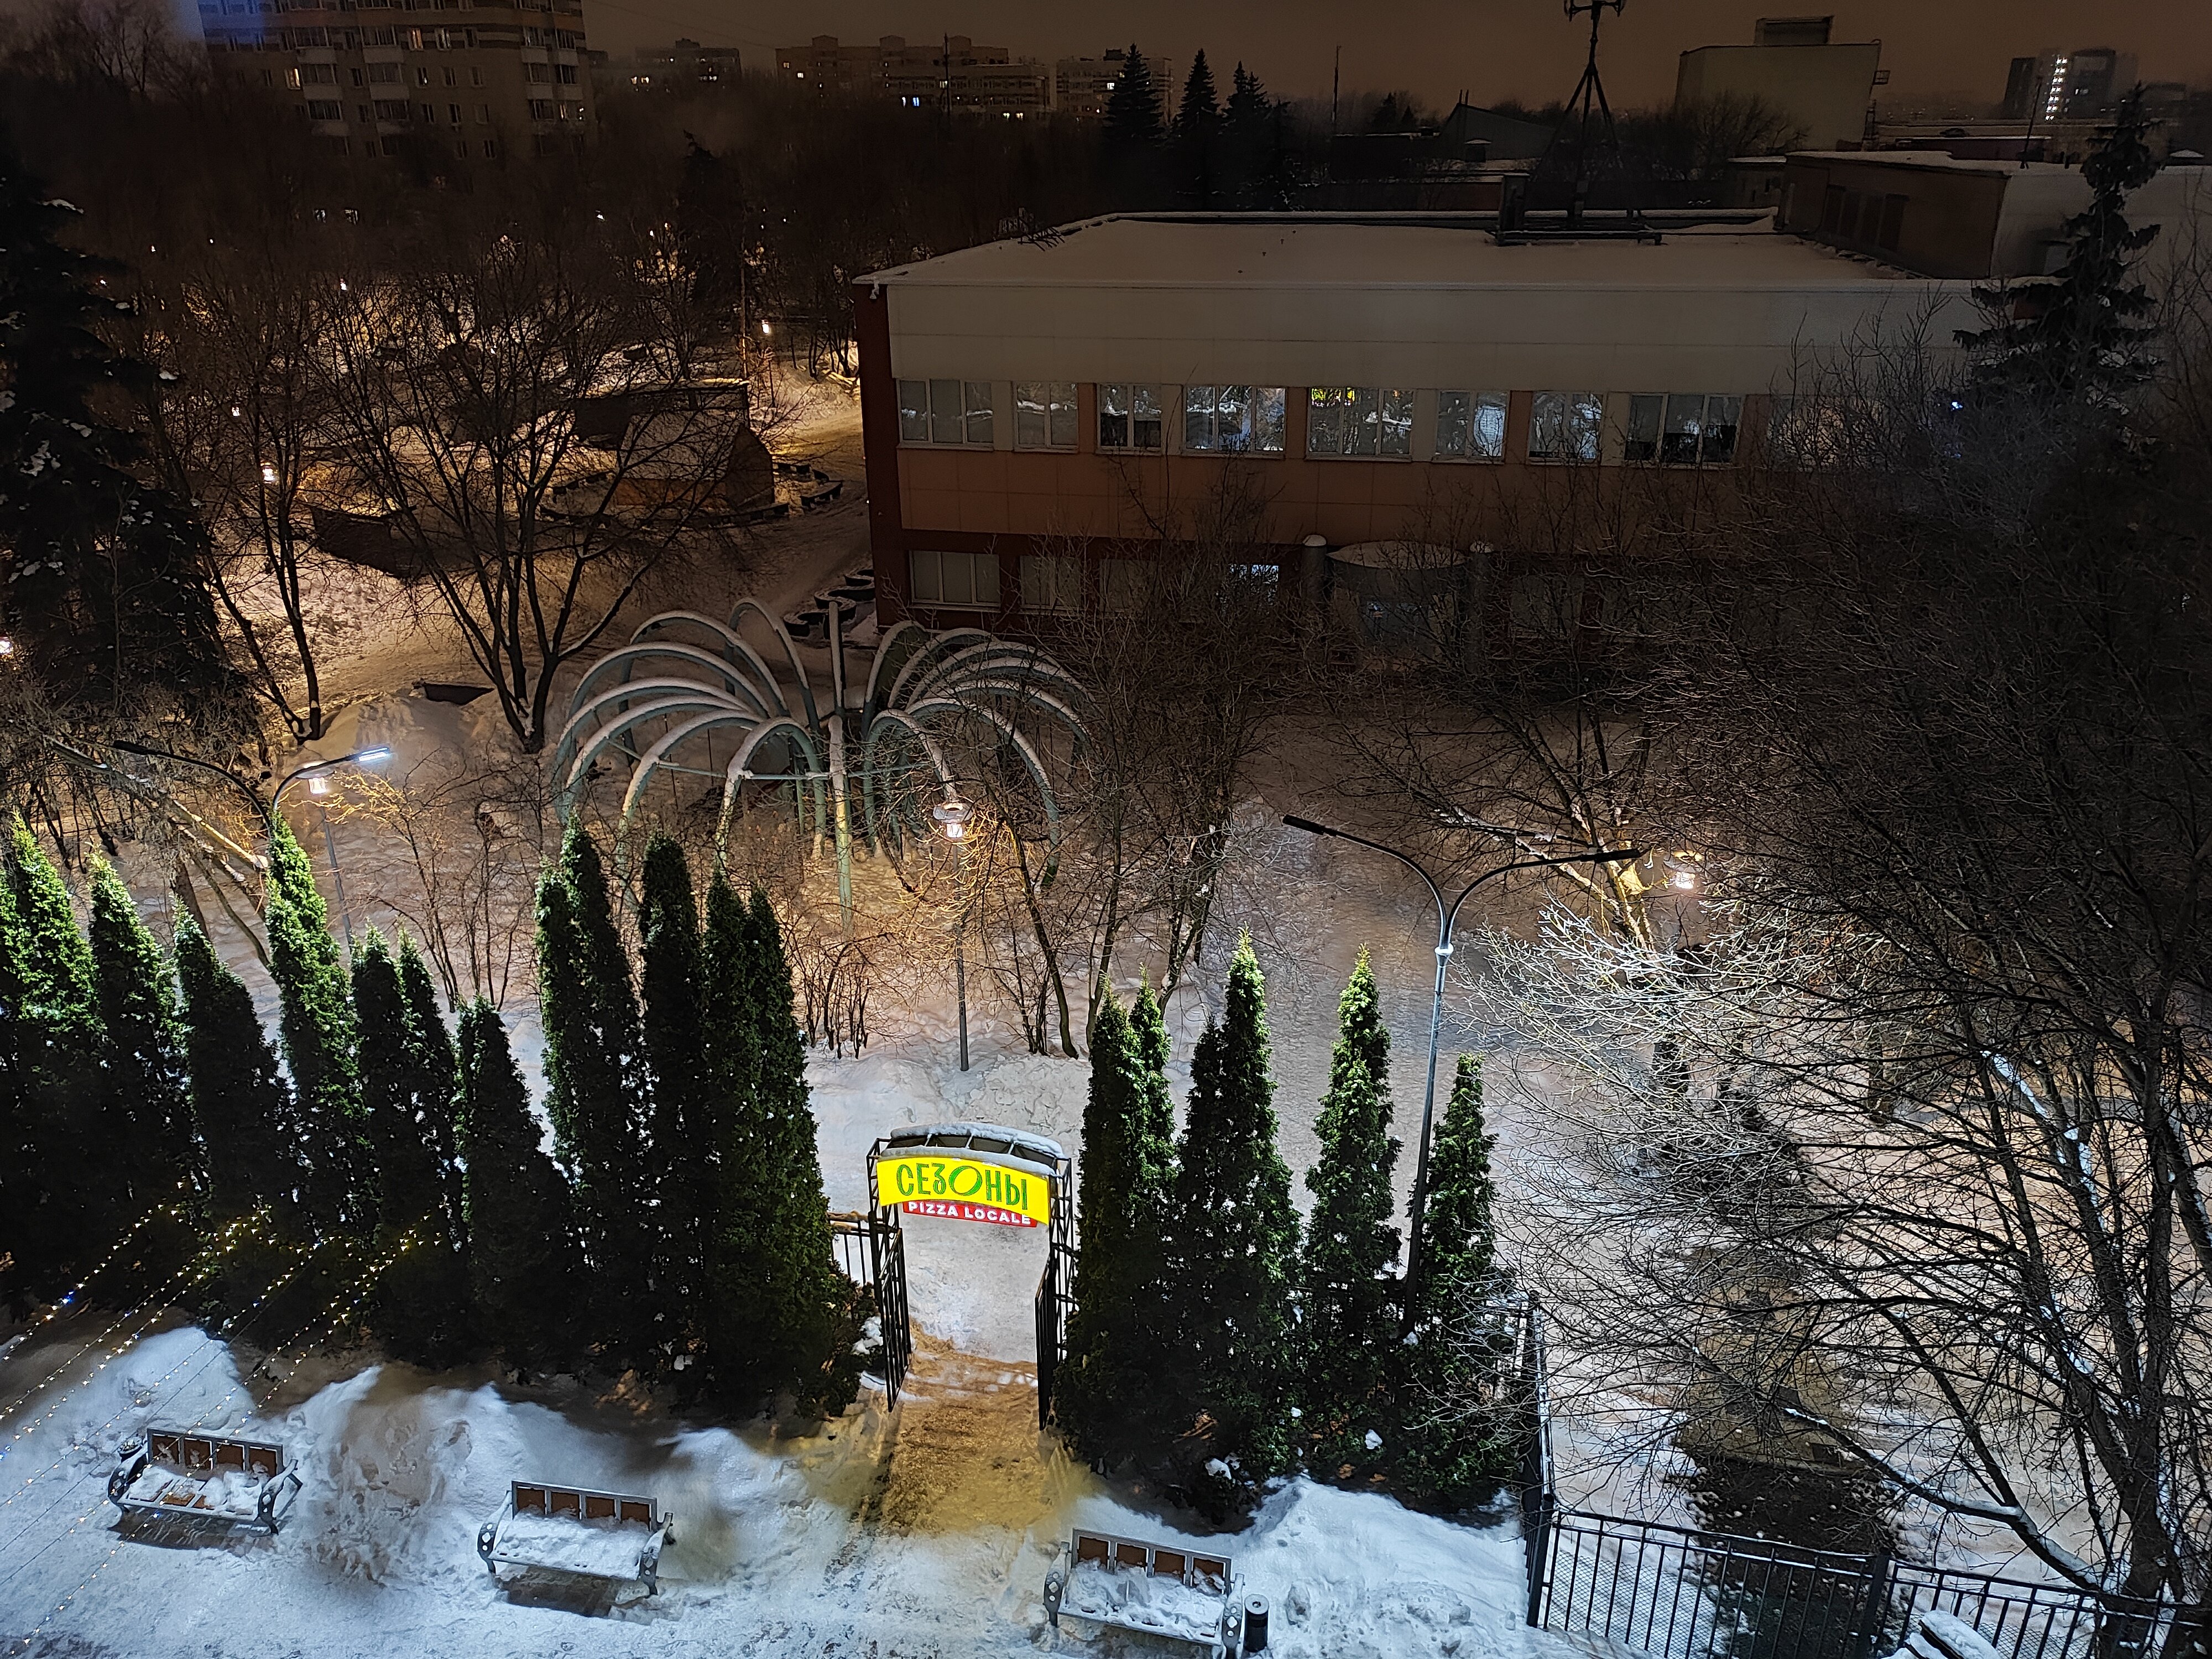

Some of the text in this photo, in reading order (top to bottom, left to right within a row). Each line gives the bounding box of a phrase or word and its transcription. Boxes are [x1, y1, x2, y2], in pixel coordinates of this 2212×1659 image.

[896, 1162, 1028, 1210] СЕЗОНЫ
[908, 1201, 1031, 1224] PIZZA LOCALE
